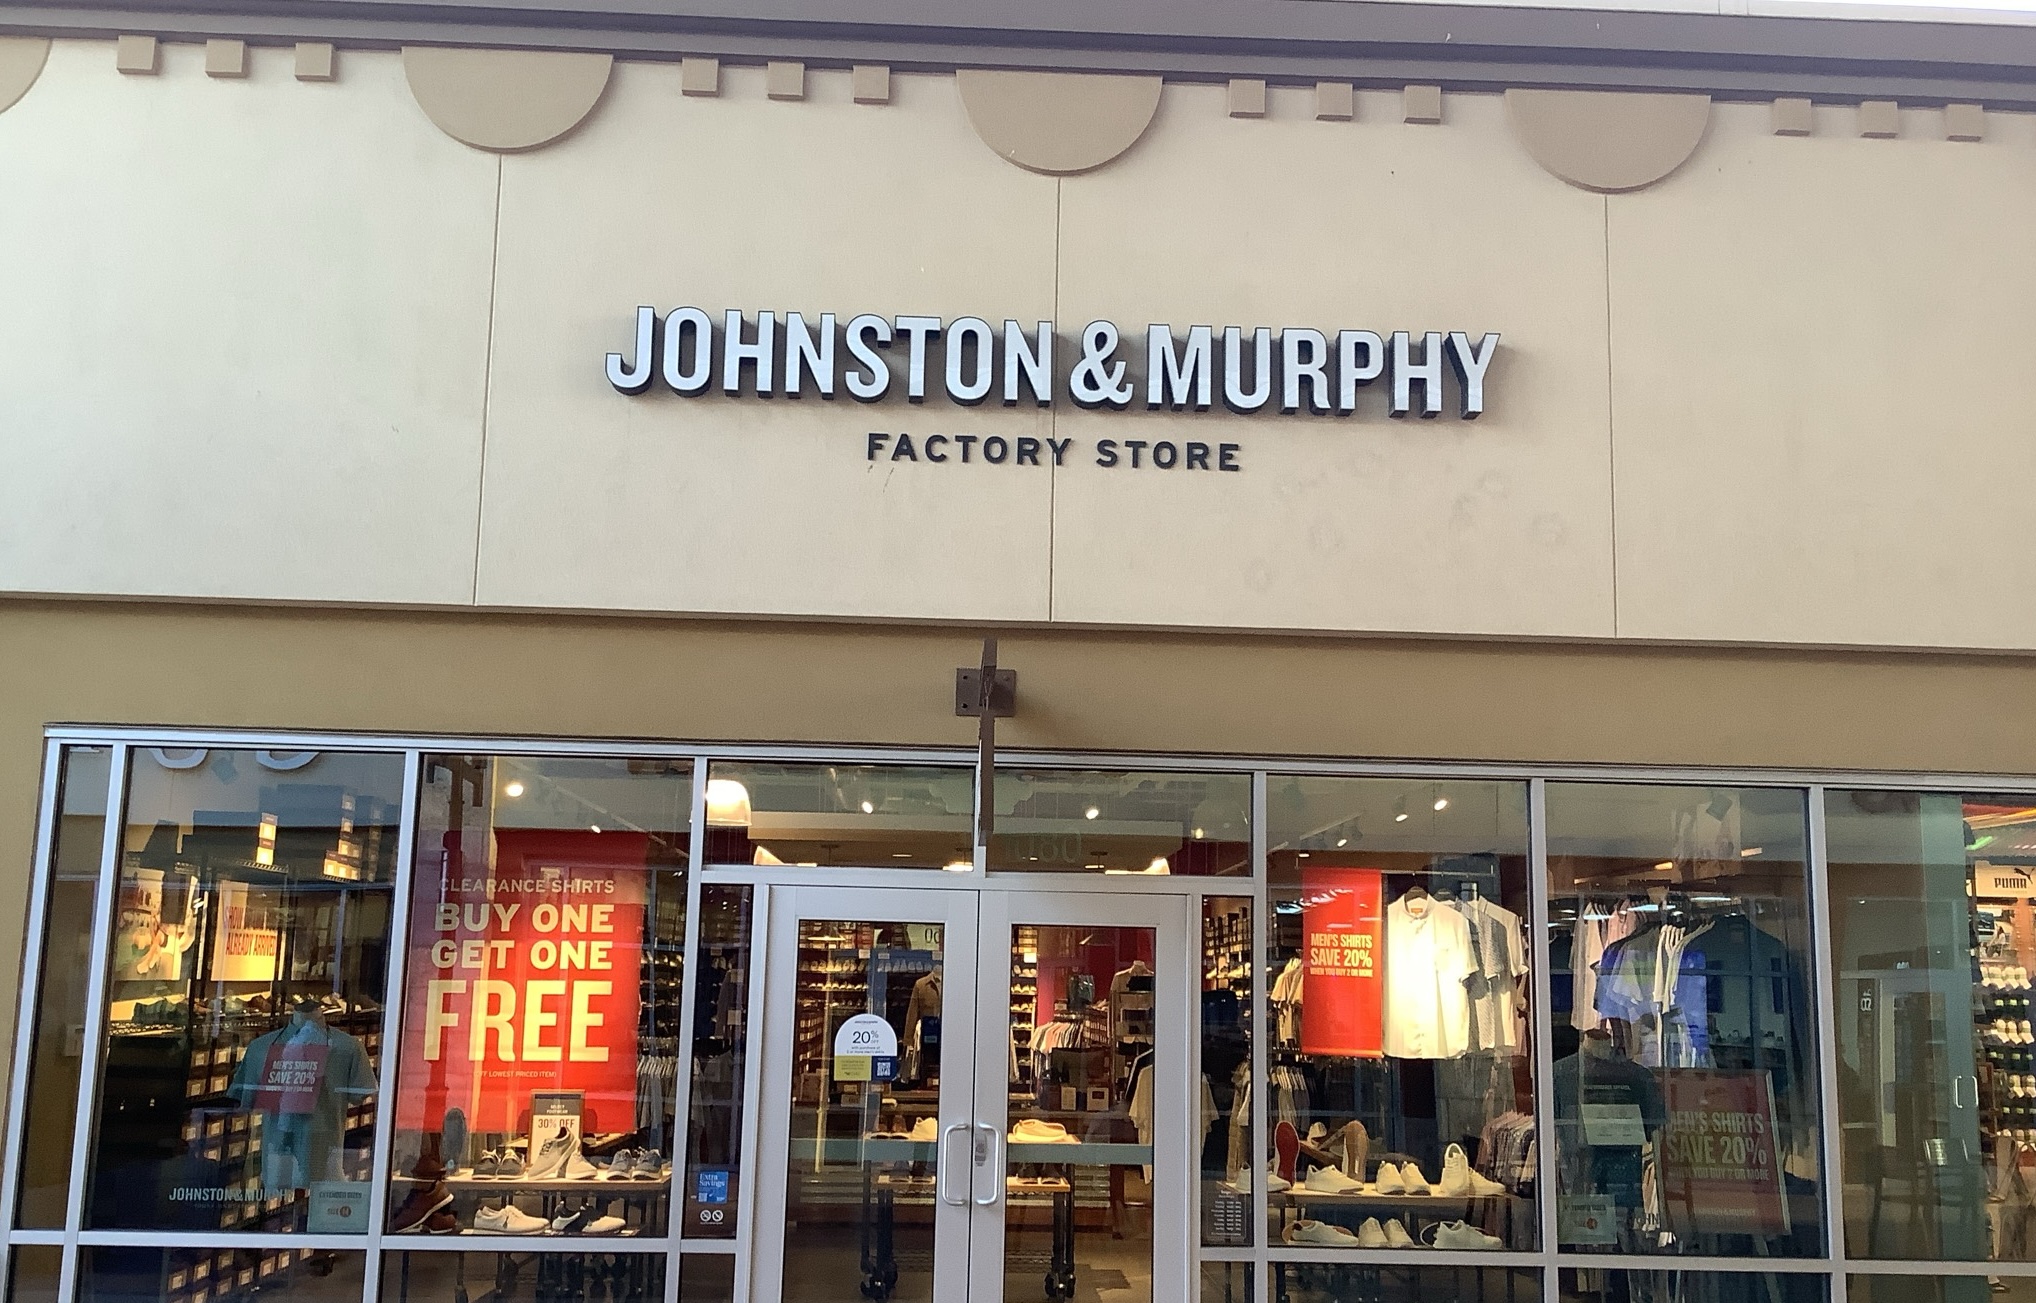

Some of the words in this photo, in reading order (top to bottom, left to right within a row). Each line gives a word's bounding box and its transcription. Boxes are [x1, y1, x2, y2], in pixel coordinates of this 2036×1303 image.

[605, 305, 1054, 406] JOHNSTON
[1069, 319, 1136, 410] &
[1146, 322, 1502, 419] MURPHY
[867, 433, 1072, 466] FACTORY
[1096, 440, 1243, 472] STORE
[439, 878, 546, 894] CLEARANCE
[552, 879, 615, 895] SHIRTS
[1994, 878, 2027, 889] PUMA
[434, 903, 521, 932] BUY
[532, 903, 615, 933] ONE
[226, 932, 253, 956] ALREADY
[1310, 933, 1339, 947] MEN'S
[1340, 934, 1373, 949] SHIRTS
[431, 939, 515, 969] GET
[530, 939, 613, 970] ONE
[1310, 947, 1341, 966] SAVE
[1343, 949, 1373, 968] 20%
[424, 979, 614, 1062] FREE
[268, 1071, 293, 1084] SAVE
[293, 1072, 316, 1085] 20%
[538, 1119, 557, 1129] 30%
[559, 1118, 575, 1129] OFF
[1711, 1111, 1765, 1134] SHIRTS
[1666, 1134, 1715, 1164] SAVE
[1720, 1136, 1768, 1165] 20%
[168, 1187, 232, 1201] JOHNSTON
[232, 1188, 243, 1202] &
